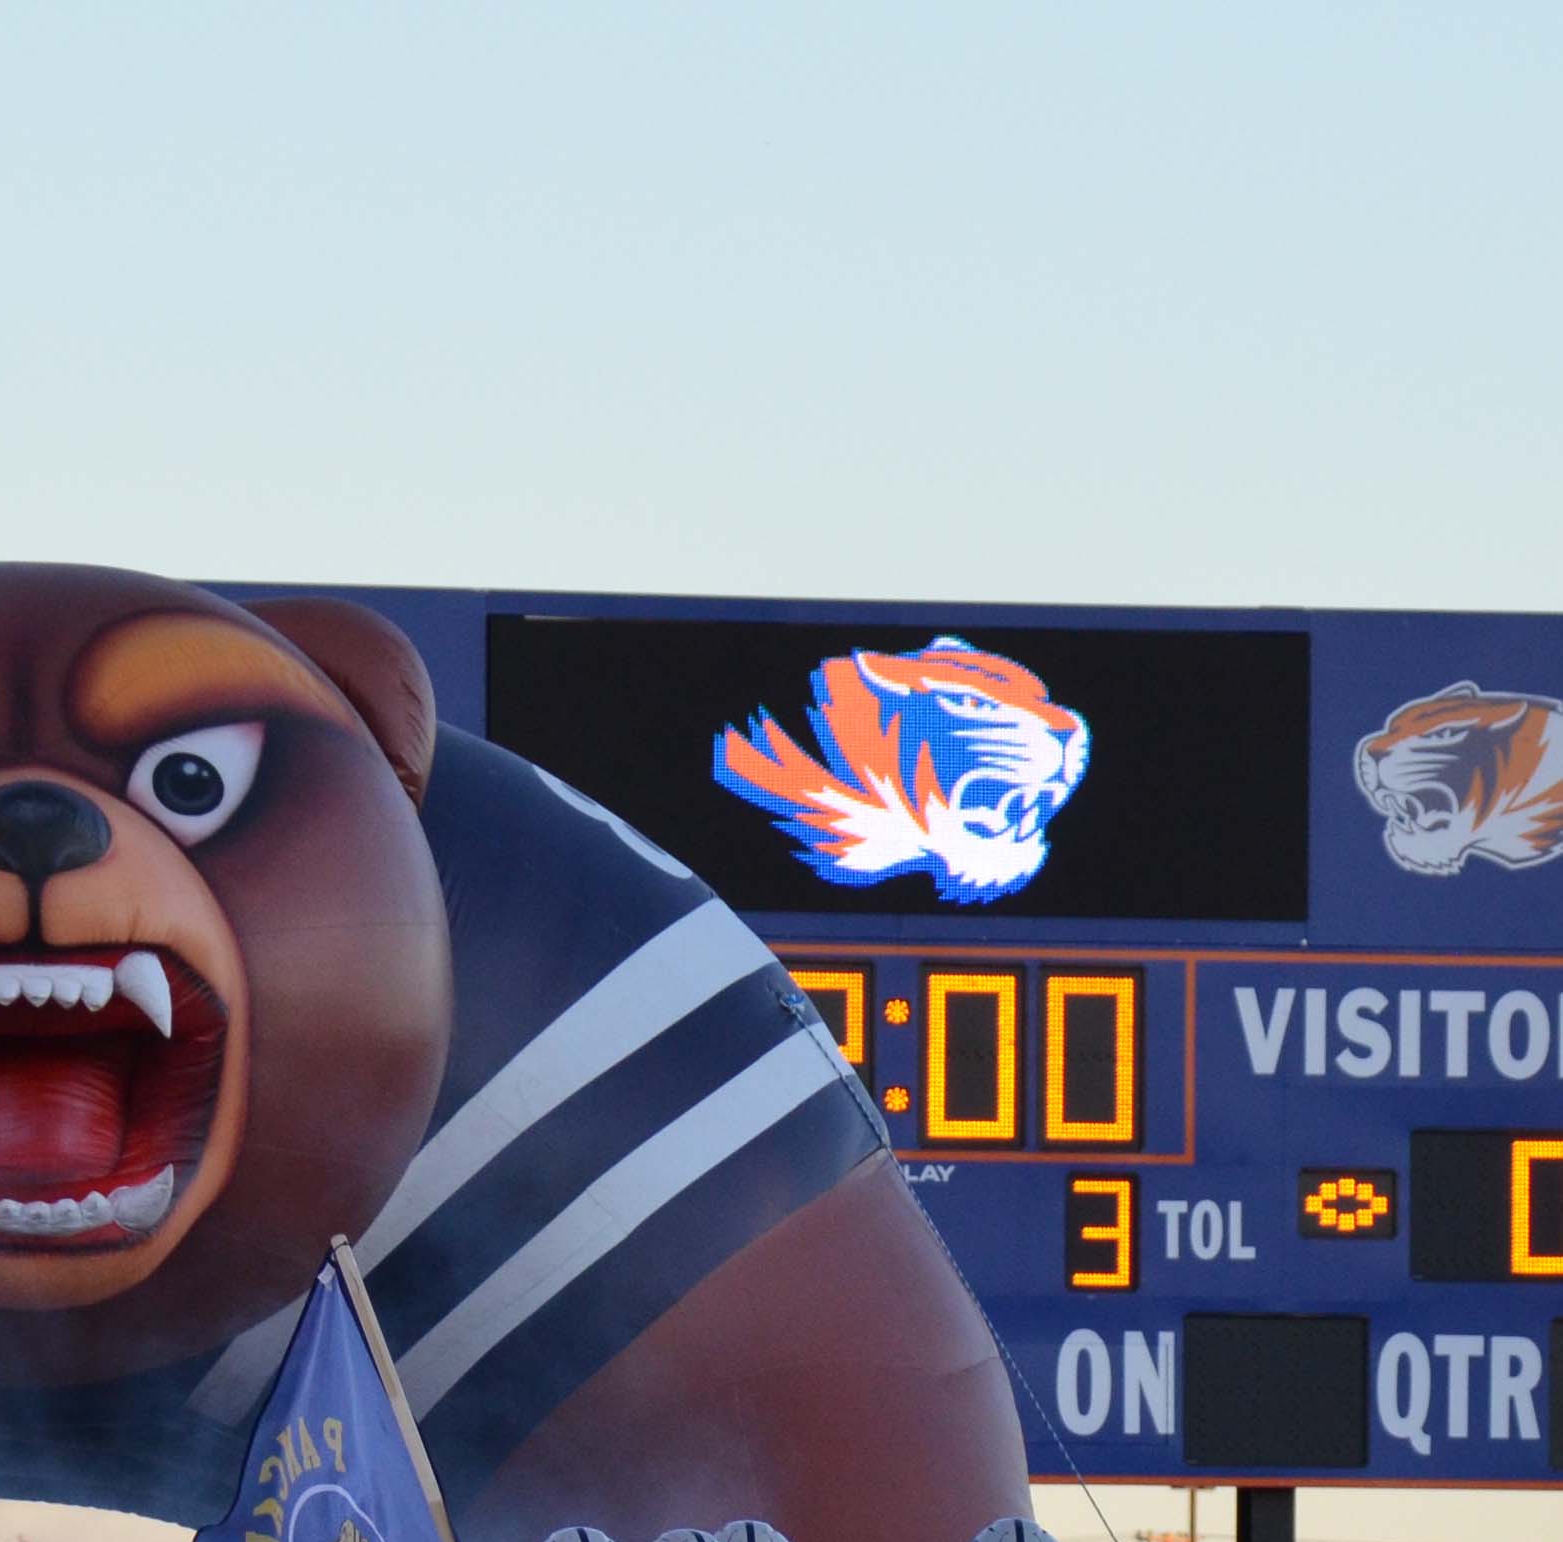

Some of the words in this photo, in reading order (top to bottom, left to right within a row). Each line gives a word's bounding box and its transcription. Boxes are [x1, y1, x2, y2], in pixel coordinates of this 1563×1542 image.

[1233, 986, 1563, 1081] VISITO
[902, 1165, 955, 1182] LAY
[1072, 1180, 1131, 1287] 3
[1157, 1200, 1257, 1261] TOL
[1055, 1327, 1176, 1437] ON
[1376, 1332, 1543, 1456] QTR
